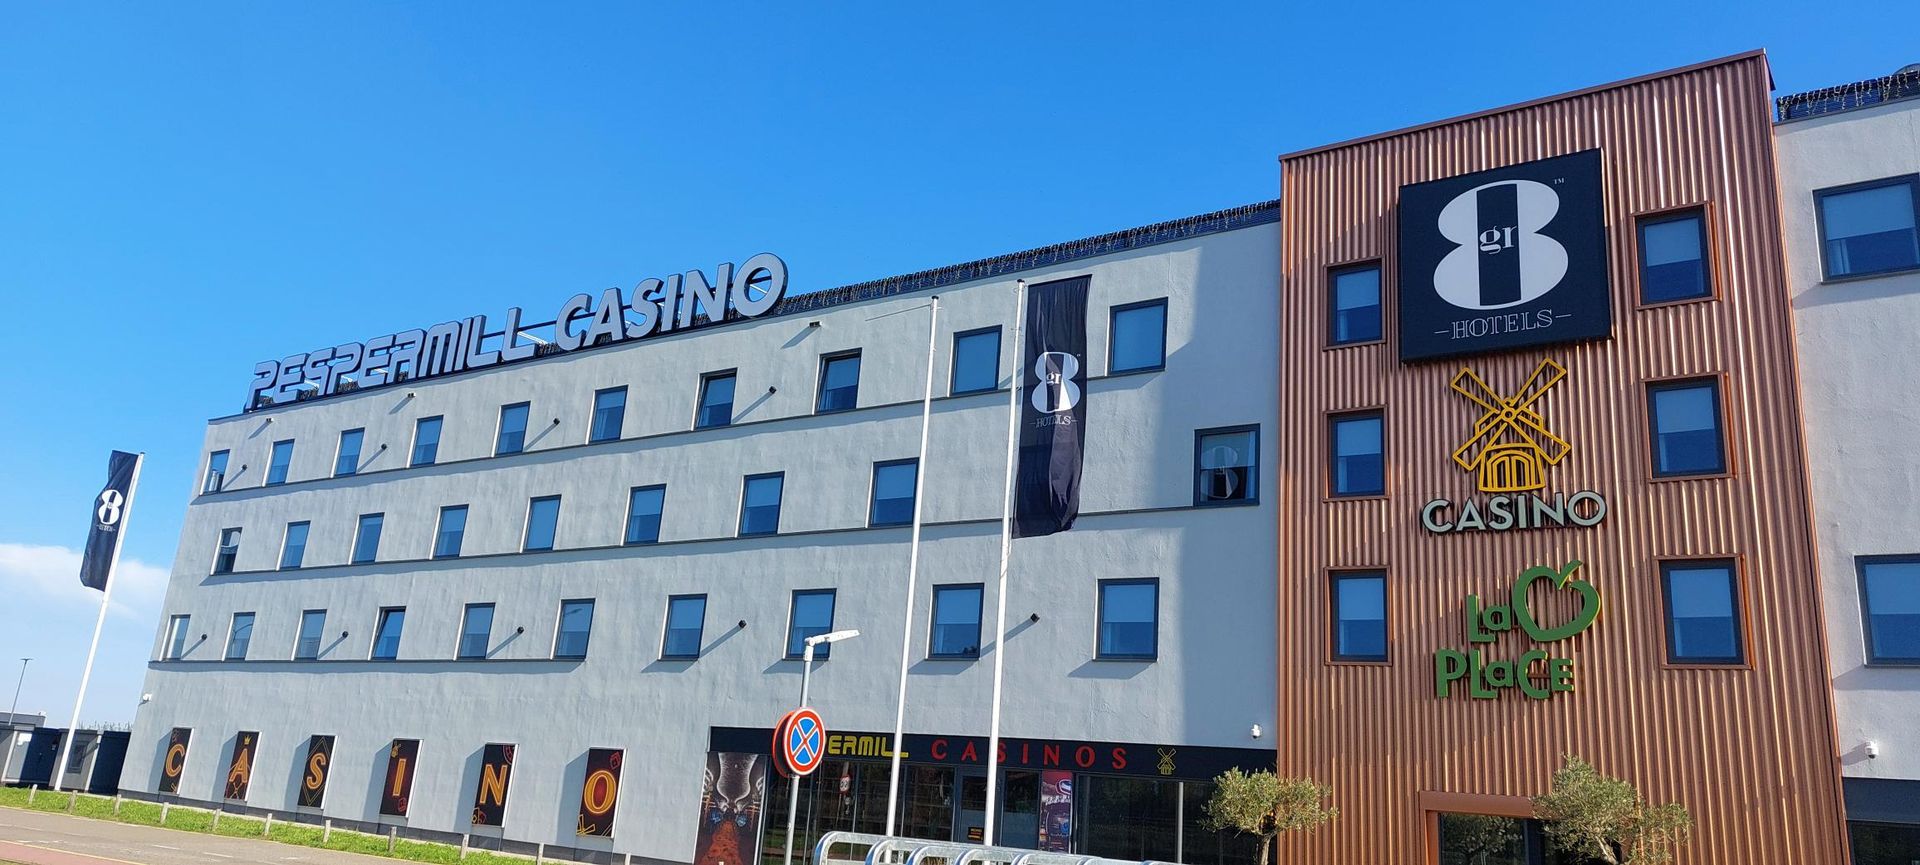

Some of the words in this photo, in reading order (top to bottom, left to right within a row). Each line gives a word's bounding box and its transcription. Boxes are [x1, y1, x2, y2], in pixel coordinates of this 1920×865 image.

[1433, 179, 1569, 310] 8
[1479, 225, 1518, 255] gr
[554, 252, 789, 351] CASINO
[1450, 308, 1553, 340] HOTELS
[1031, 351, 1081, 413] 8
[98, 489, 123, 525] 8
[1422, 490, 1608, 534] CASINO
